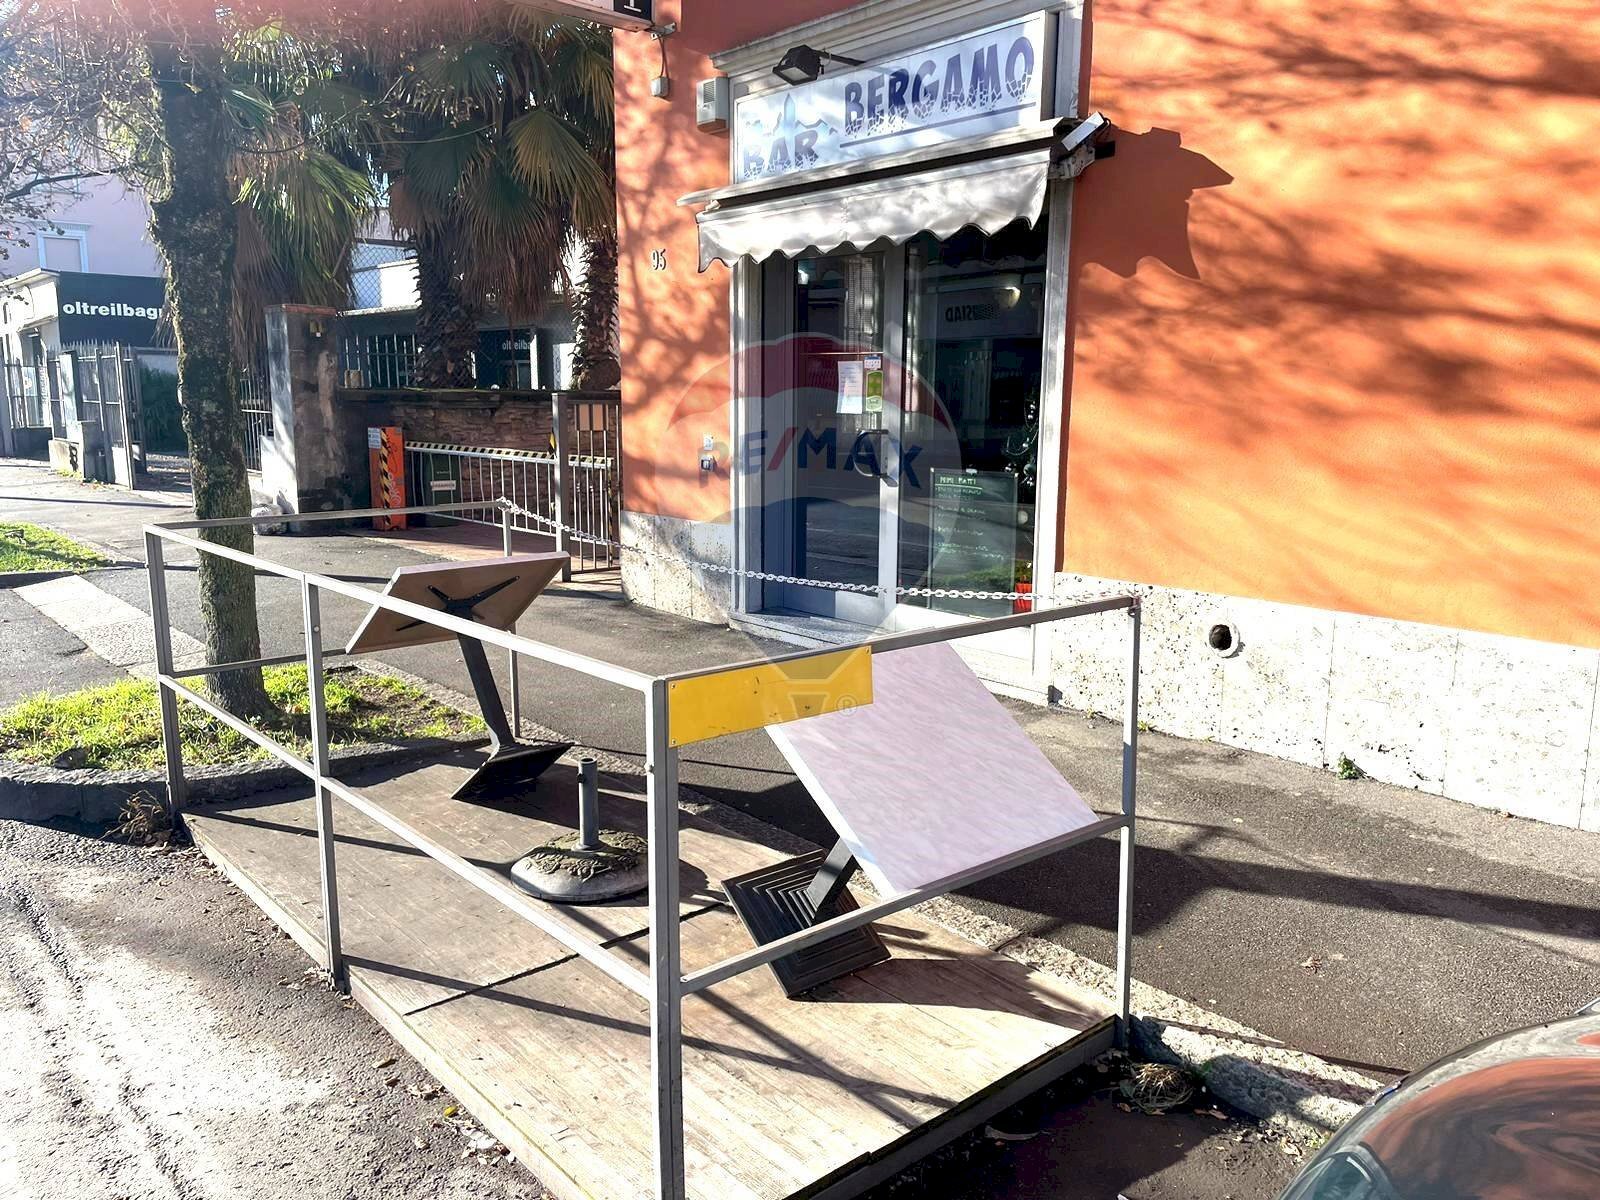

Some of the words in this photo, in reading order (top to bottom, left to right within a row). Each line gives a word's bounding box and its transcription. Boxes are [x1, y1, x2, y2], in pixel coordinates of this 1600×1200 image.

[743, 130, 820, 179] BAR
[844, 36, 1035, 137] BERGAMO
[651, 249, 667, 271] 95
[62, 301, 163, 320] oltreilbag
